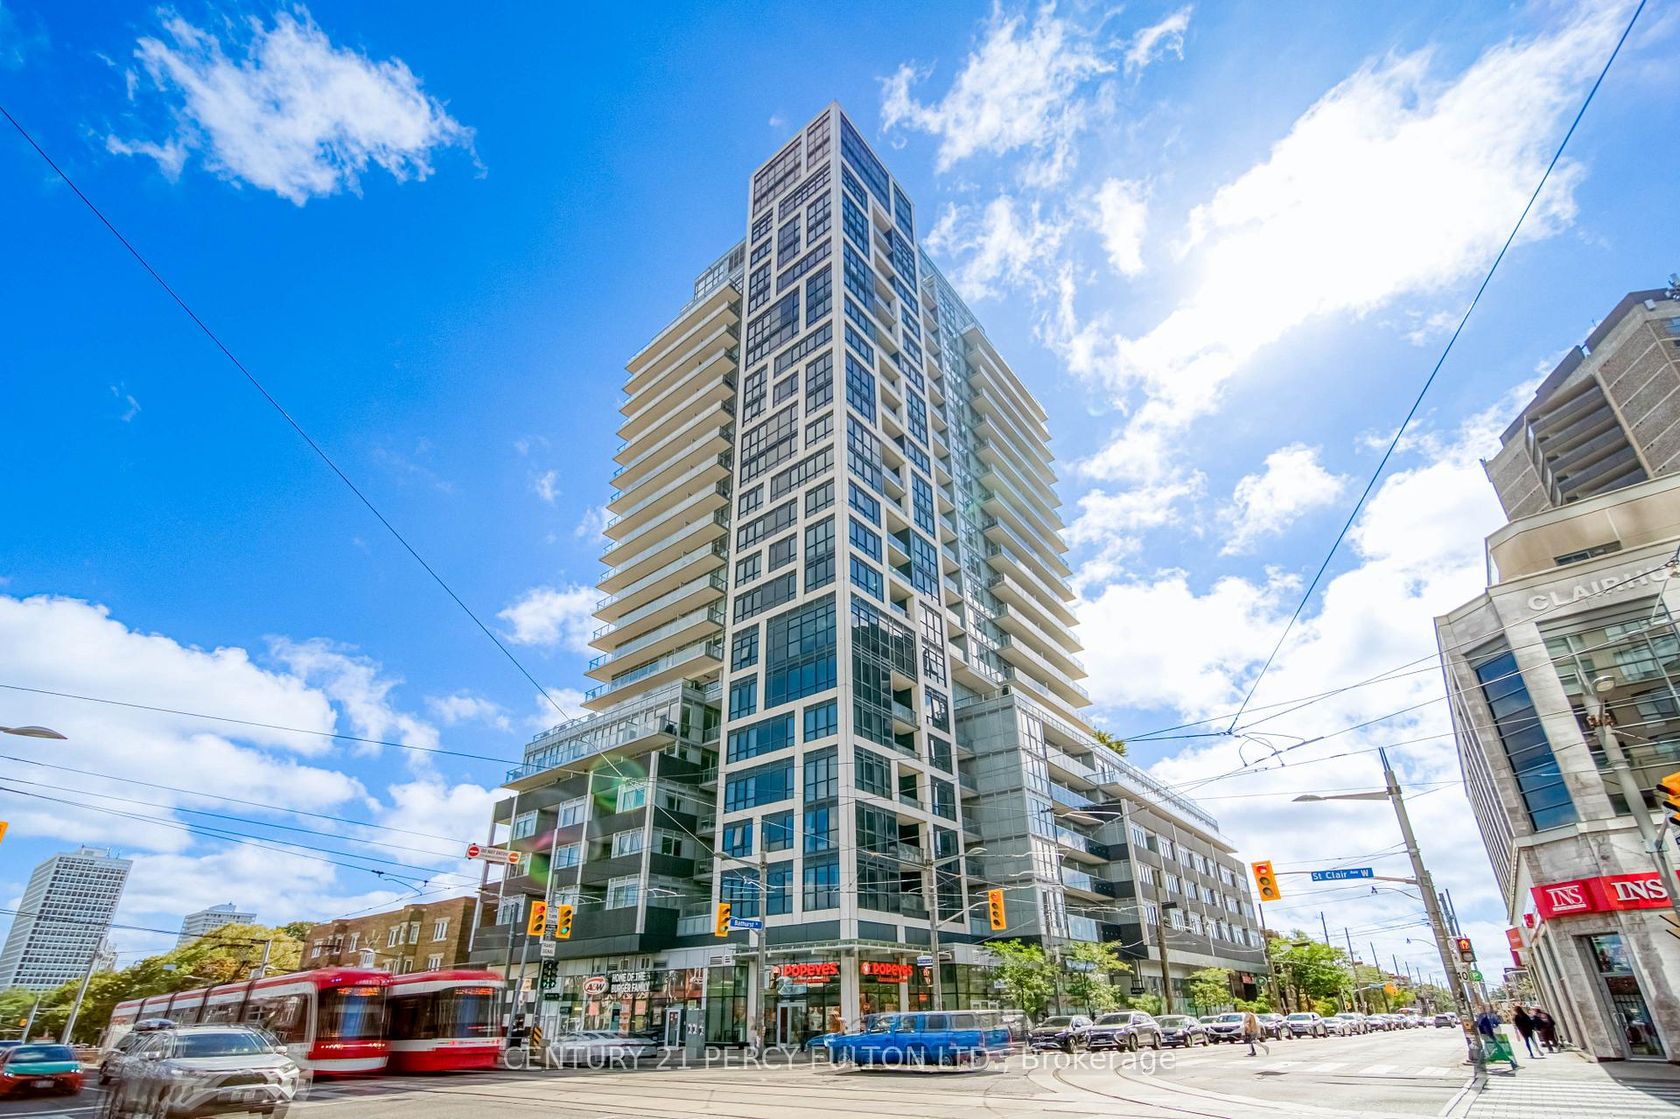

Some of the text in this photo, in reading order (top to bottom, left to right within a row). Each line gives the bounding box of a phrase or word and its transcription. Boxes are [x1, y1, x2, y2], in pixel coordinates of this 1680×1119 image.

[1325, 871, 1347, 879] Clair
[1360, 869, 1369, 877] W
[1611, 879, 1668, 901] INS
[1549, 888, 1583, 907] INS
[734, 919, 755, 928] Bathurst
[612, 972, 646, 982] HOME OF THE
[611, 981, 650, 993] BURGER FAMILY
